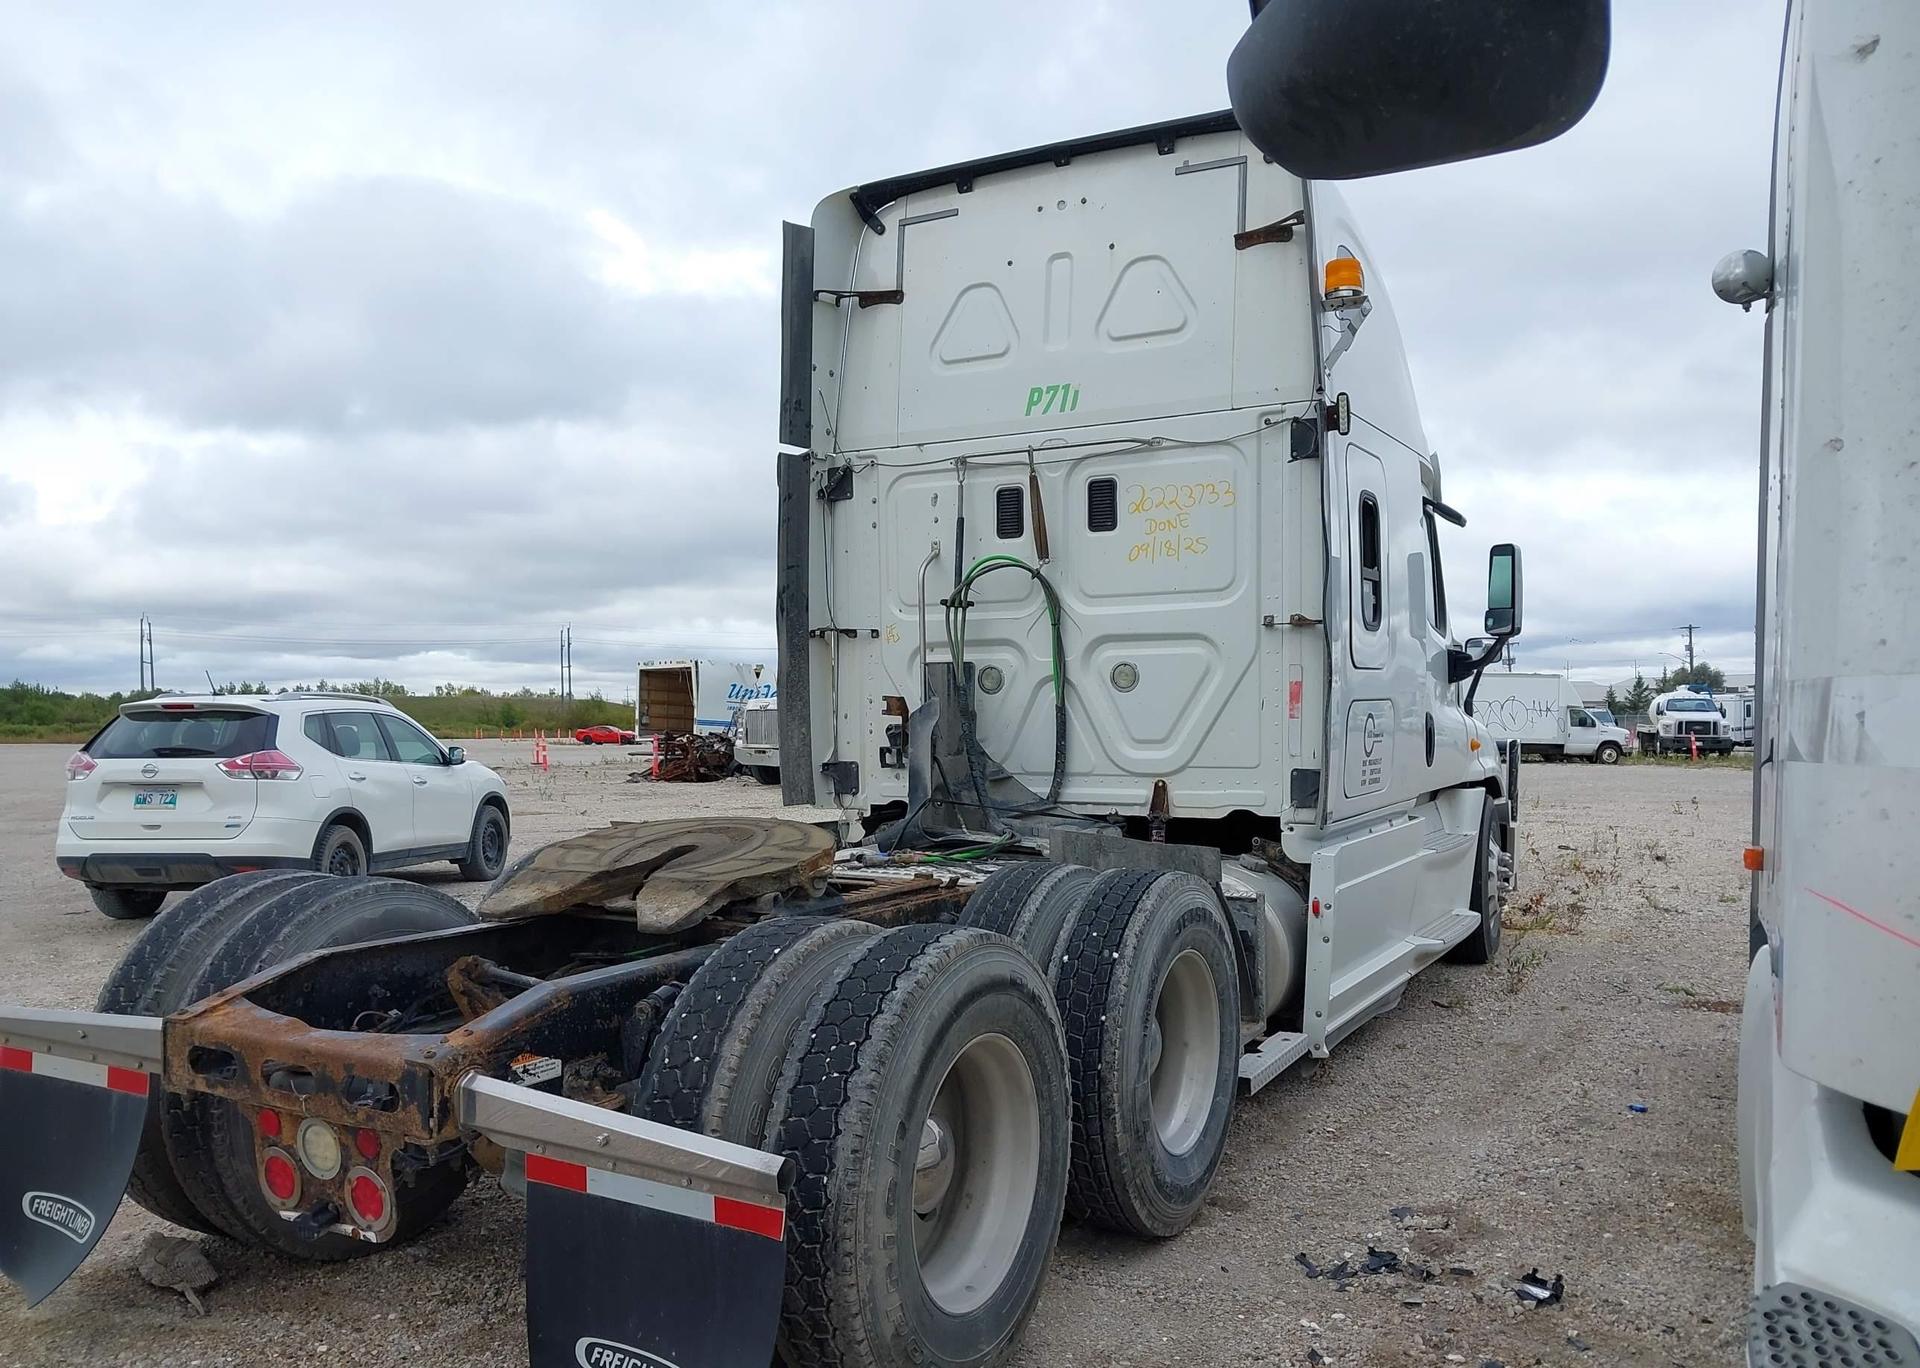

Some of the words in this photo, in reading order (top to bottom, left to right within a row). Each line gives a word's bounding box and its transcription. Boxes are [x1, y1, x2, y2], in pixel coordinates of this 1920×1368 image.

[1126, 480, 1236, 515] 20223733
[1145, 513, 1190, 535] DONE
[1129, 534, 1208, 564] 09/18/25
[136, 793, 153, 805] GWS
[159, 793, 176, 805] 722
[32, 1198, 90, 1236] FREIGHTLINER
